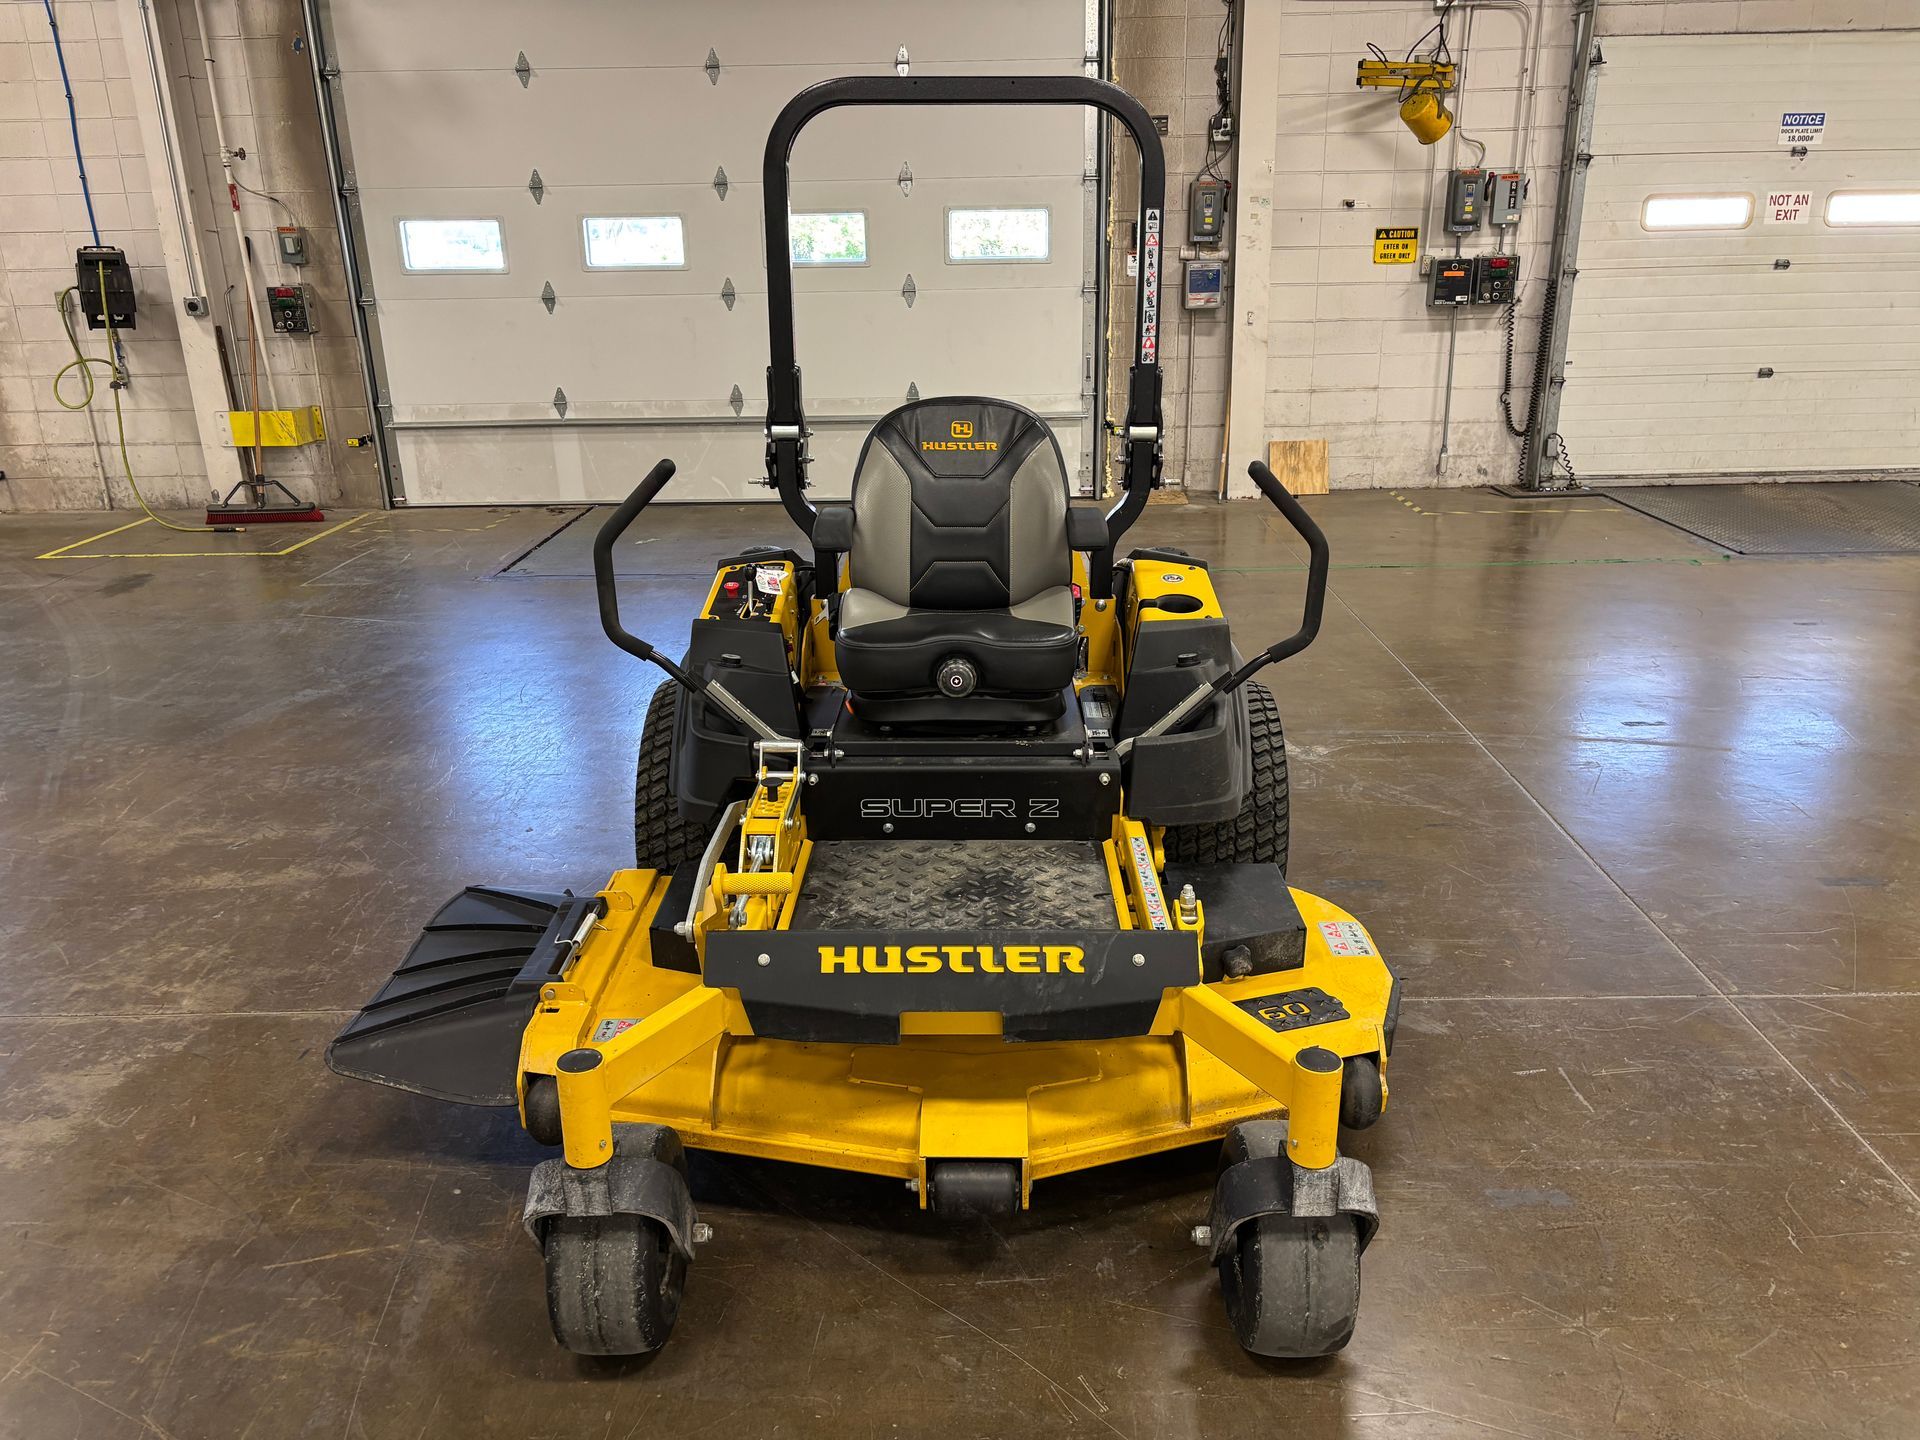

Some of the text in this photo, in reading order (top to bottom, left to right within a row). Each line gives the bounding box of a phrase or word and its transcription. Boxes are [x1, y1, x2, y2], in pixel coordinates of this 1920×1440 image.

[1783, 115, 1823, 125] NOTICE
[1769, 194, 1810, 206] NOT AN
[1775, 209, 1800, 221] EXIT
[1389, 230, 1415, 238] CAUTION
[922, 441, 998, 451] HUSTLER
[860, 798, 1060, 818] SUPER Z
[818, 945, 1085, 974] HUSTLER
[1257, 1001, 1311, 1021] 60
